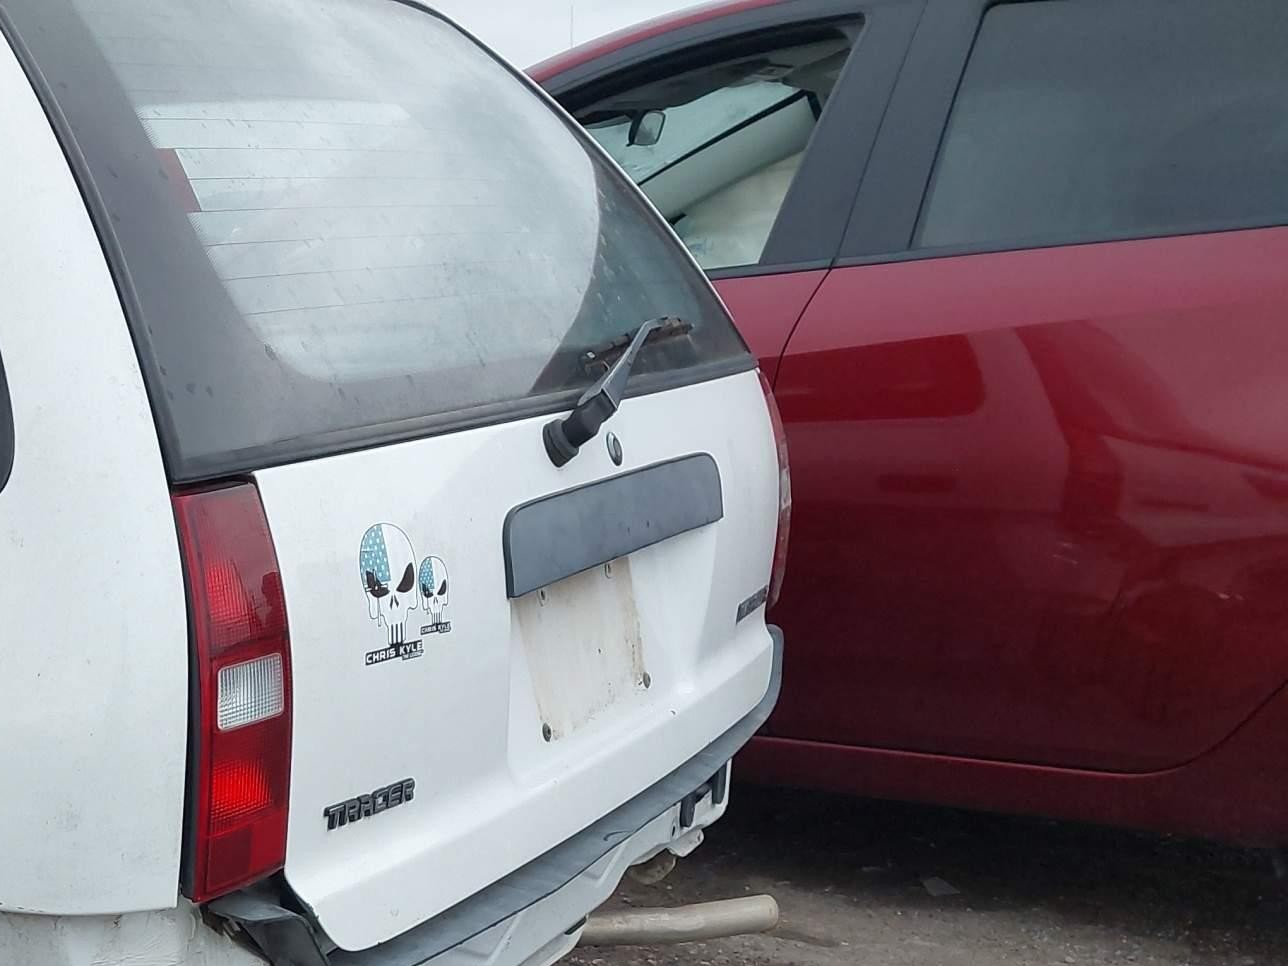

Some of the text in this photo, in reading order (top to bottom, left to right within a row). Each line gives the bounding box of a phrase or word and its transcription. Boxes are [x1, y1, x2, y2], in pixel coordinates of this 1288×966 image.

[366, 648, 396, 664] CHRIS
[399, 641, 423, 655] KYLE
[323, 778, 415, 831] TRACER
